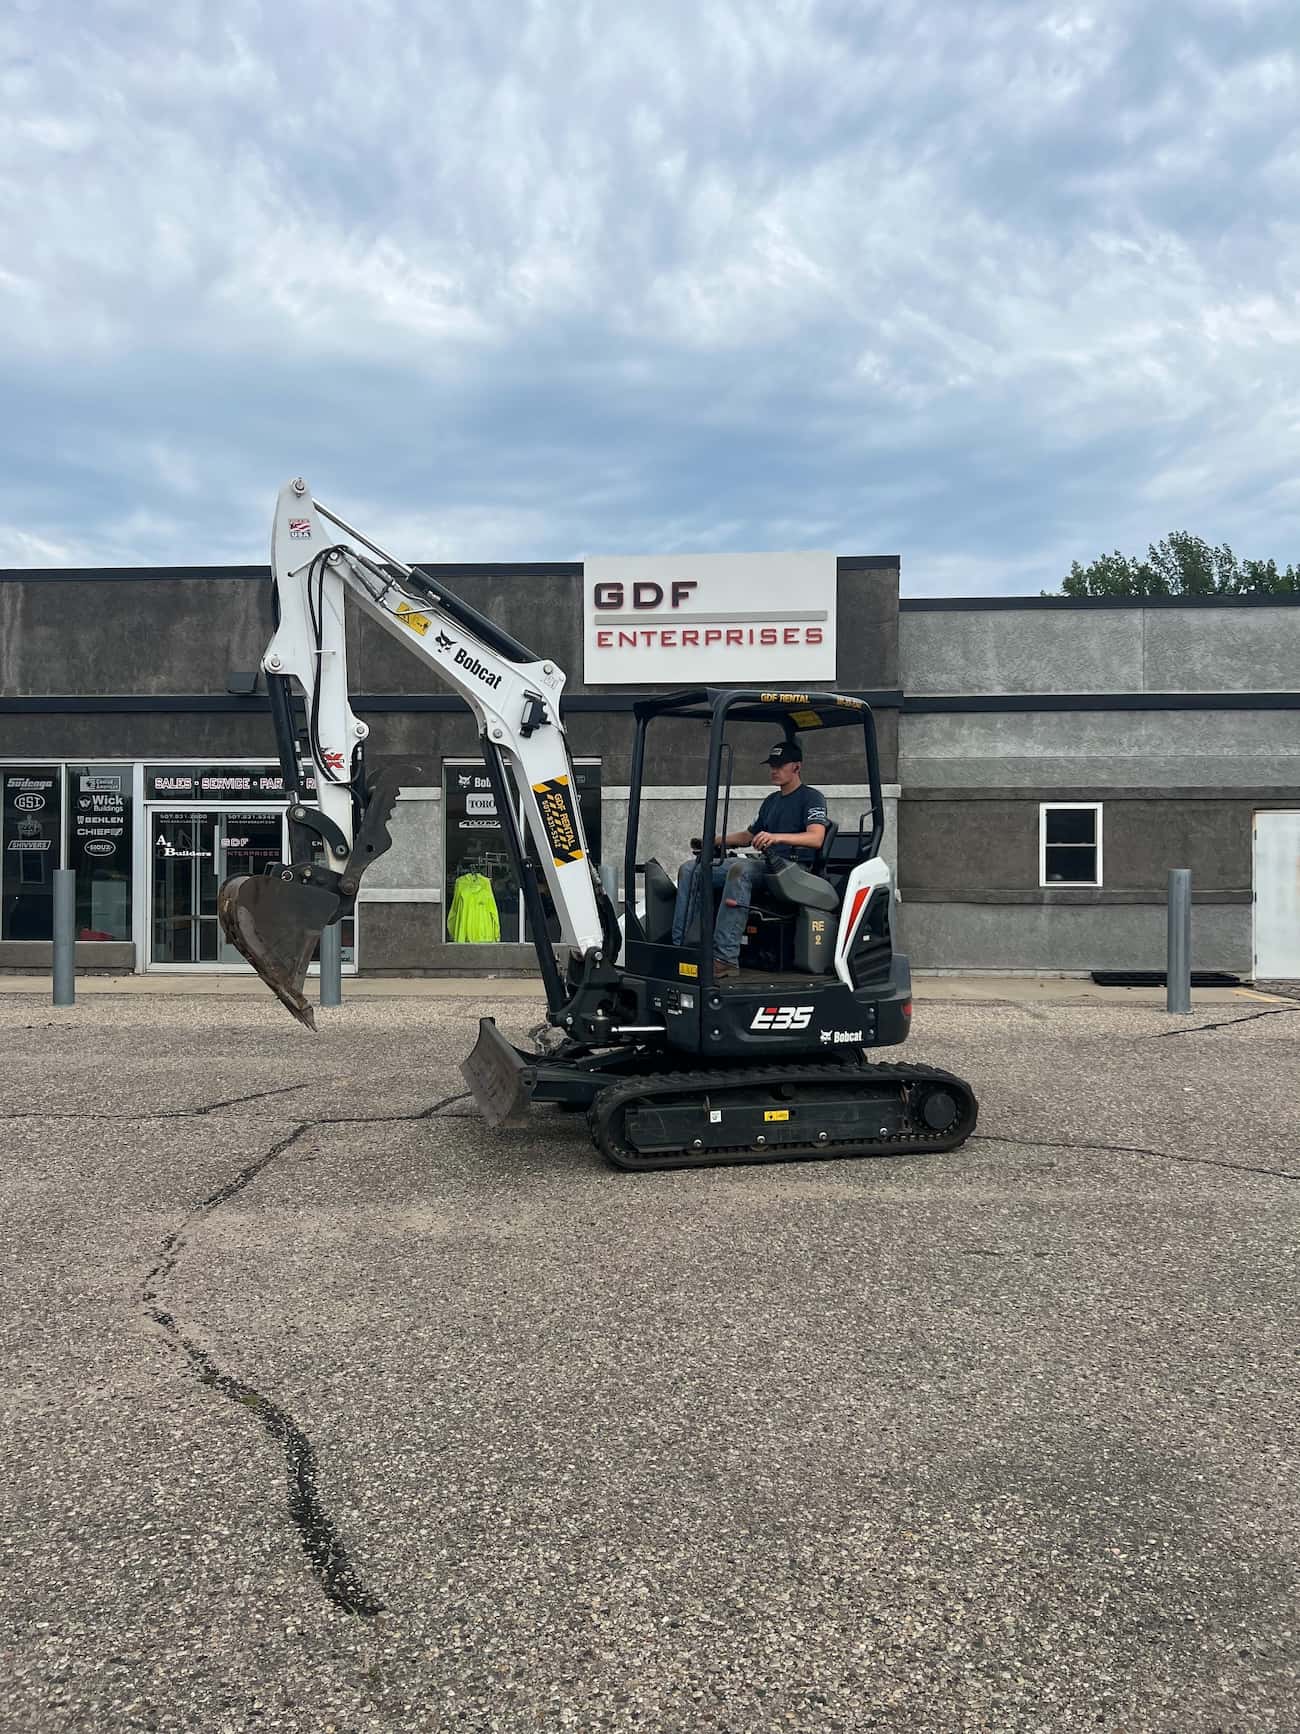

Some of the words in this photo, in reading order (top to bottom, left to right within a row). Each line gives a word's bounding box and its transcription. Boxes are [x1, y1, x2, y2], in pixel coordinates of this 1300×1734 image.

[594, 581, 697, 609] GDF
[597, 627, 823, 647] ENTERPRISES
[454, 648, 502, 690] Bobcat
[760, 693, 778, 703] GDF
[779, 694, 810, 704] RENTAL
[155, 777, 192, 790] SALES
[201, 777, 250, 790] SERVICE
[260, 777, 284, 790] PAR
[474, 777, 492, 788] Bob
[18, 796, 41, 808] GSI
[92, 795, 124, 805] Wick
[470, 800, 496, 809] TORO
[93, 805, 124, 813] Buildings
[554, 793, 566, 811] GDF
[560, 813, 575, 847] RENTAL
[76, 828, 110, 836] CHIEF
[221, 838, 249, 848] GDF
[164, 847, 212, 857] Builders
[812, 921, 824, 932] RE
[815, 935, 822, 945] 2
[750, 1006, 815, 1030] E35
[833, 1030, 863, 1043] Bobcat
